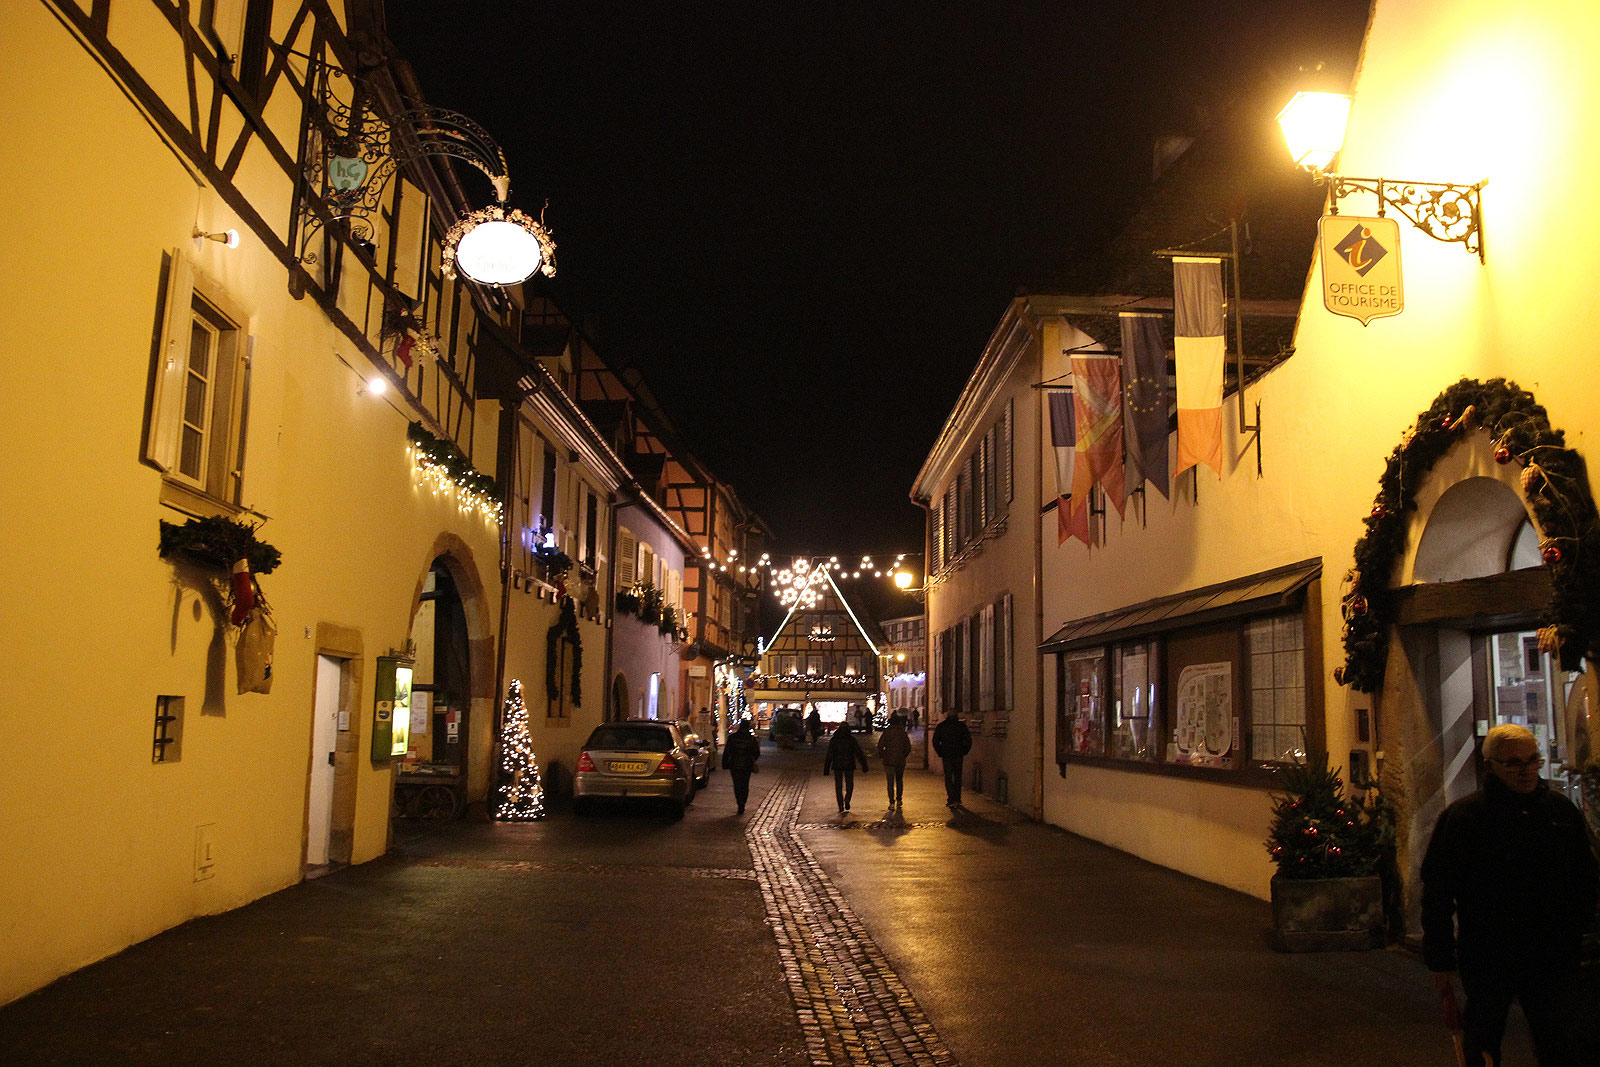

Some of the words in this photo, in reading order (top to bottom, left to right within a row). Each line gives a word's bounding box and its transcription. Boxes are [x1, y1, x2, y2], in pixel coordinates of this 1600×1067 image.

[1329, 283, 1375, 295] OFFICE
[1380, 285, 1397, 296] DE
[1331, 295, 1397, 309] TOURISME
